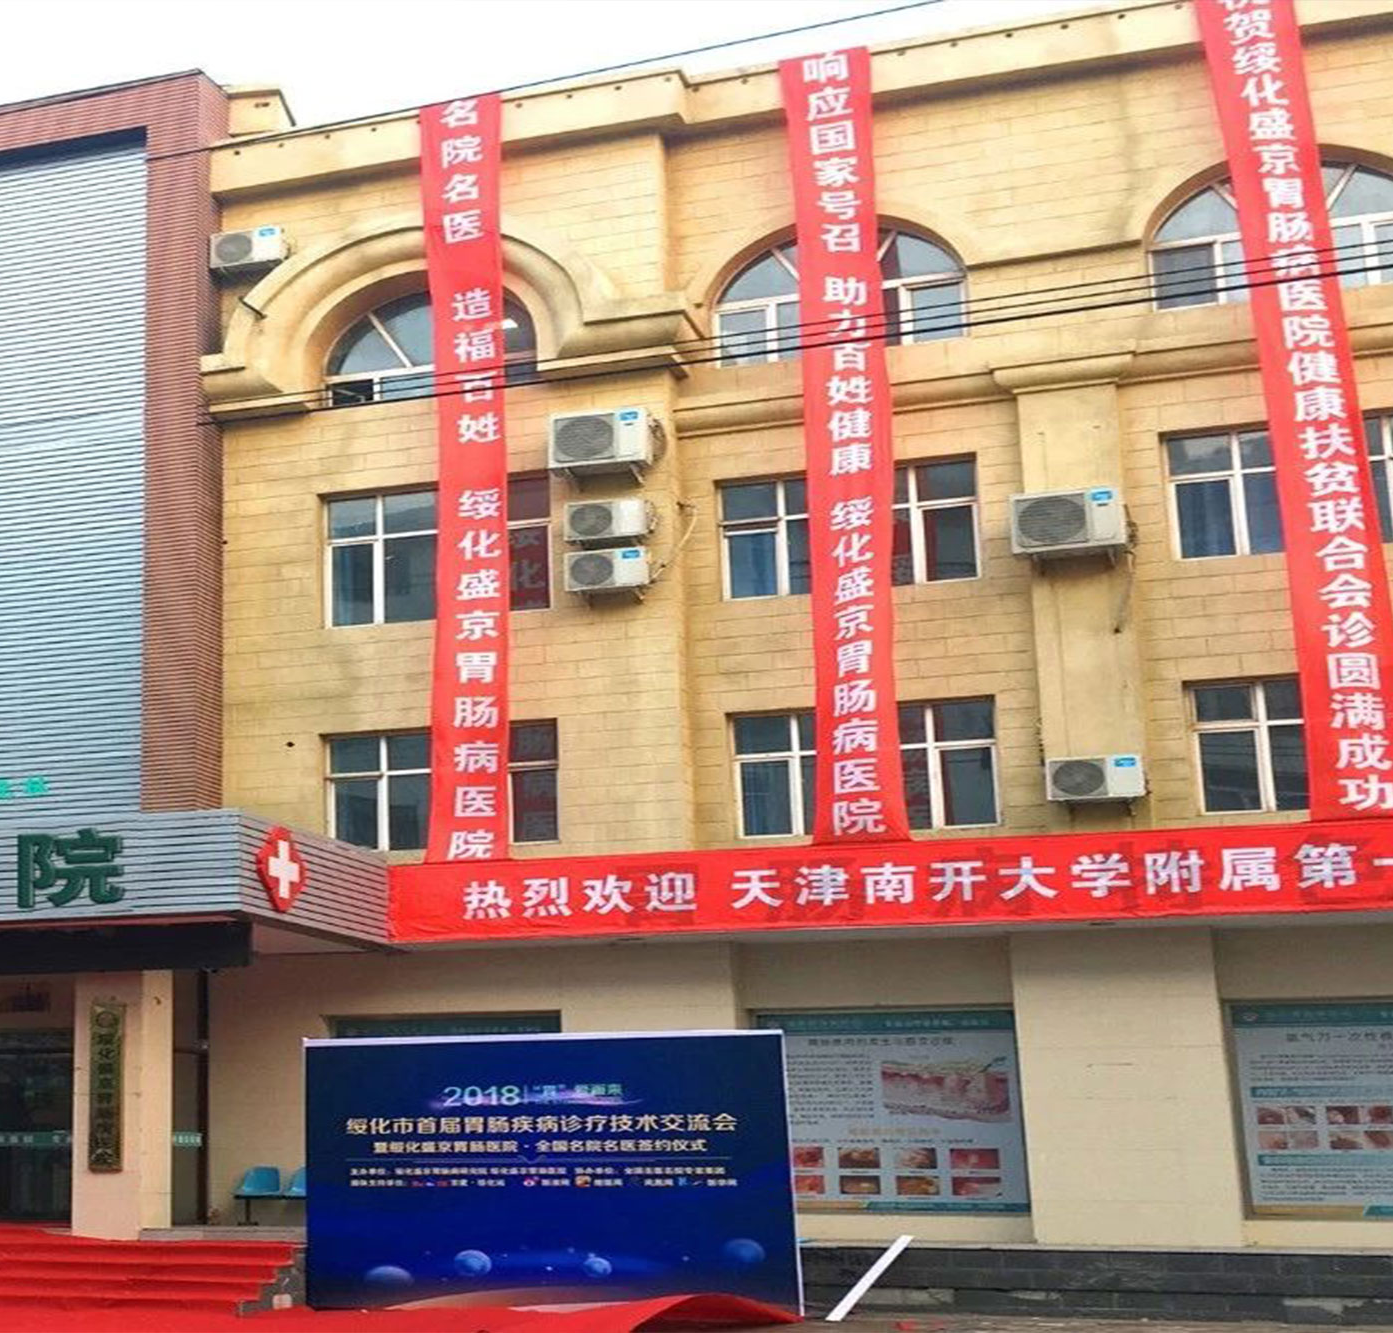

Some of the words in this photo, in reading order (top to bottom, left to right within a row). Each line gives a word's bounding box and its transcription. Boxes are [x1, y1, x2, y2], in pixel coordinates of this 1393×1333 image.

[439, 99, 483, 244] 名院名医
[802, 53, 862, 253] 响应国家号召
[451, 288, 500, 444] 造福百姓
[823, 276, 873, 477] 助力百姓健康
[448, 489, 501, 859] 绥化盛京胃肠病医院
[829, 496, 886, 837] 绥化盛京胃肠病医院
[462, 870, 698, 921] 热烈欢迎
[346, 1113, 738, 1136] 绥化市首届胃肠疾病诊疗技术交流会
[443, 1085, 521, 1107] 2018
